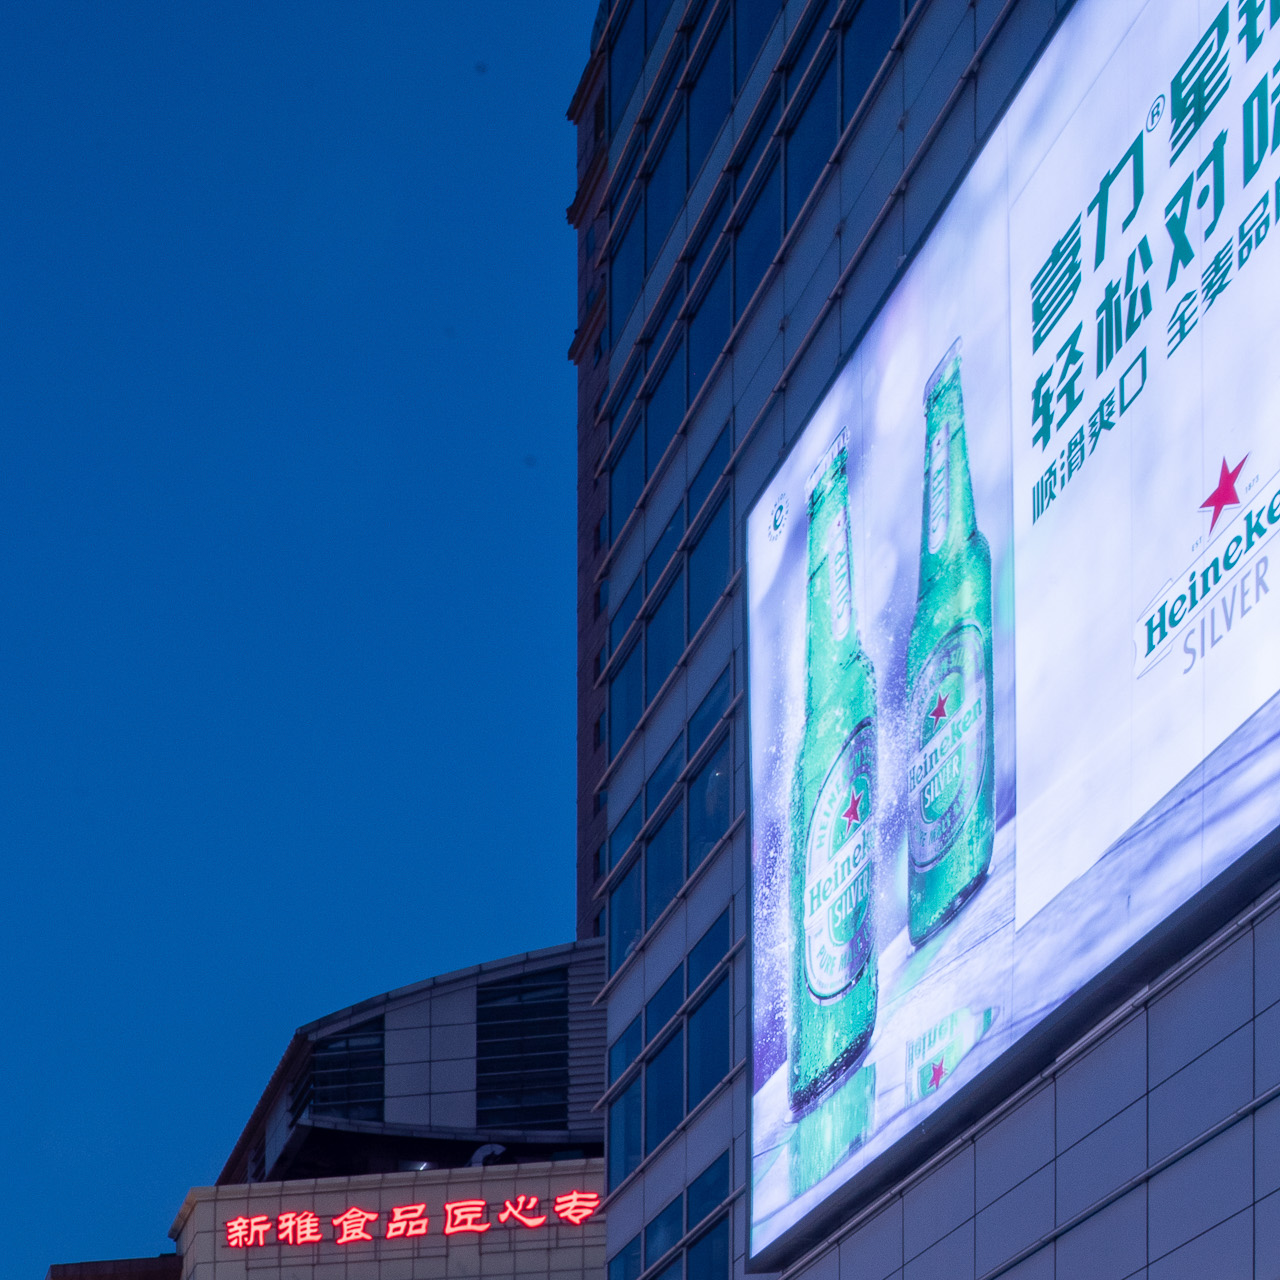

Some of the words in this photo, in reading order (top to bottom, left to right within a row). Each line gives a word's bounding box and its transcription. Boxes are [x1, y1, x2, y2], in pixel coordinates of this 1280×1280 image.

[1032, 345, 1147, 526] 顺滑爽口
[1166, 175, 1280, 360] 全麦品
[1183, 555, 1270, 675] SILVER
[924, 754, 960, 809] SILVER
